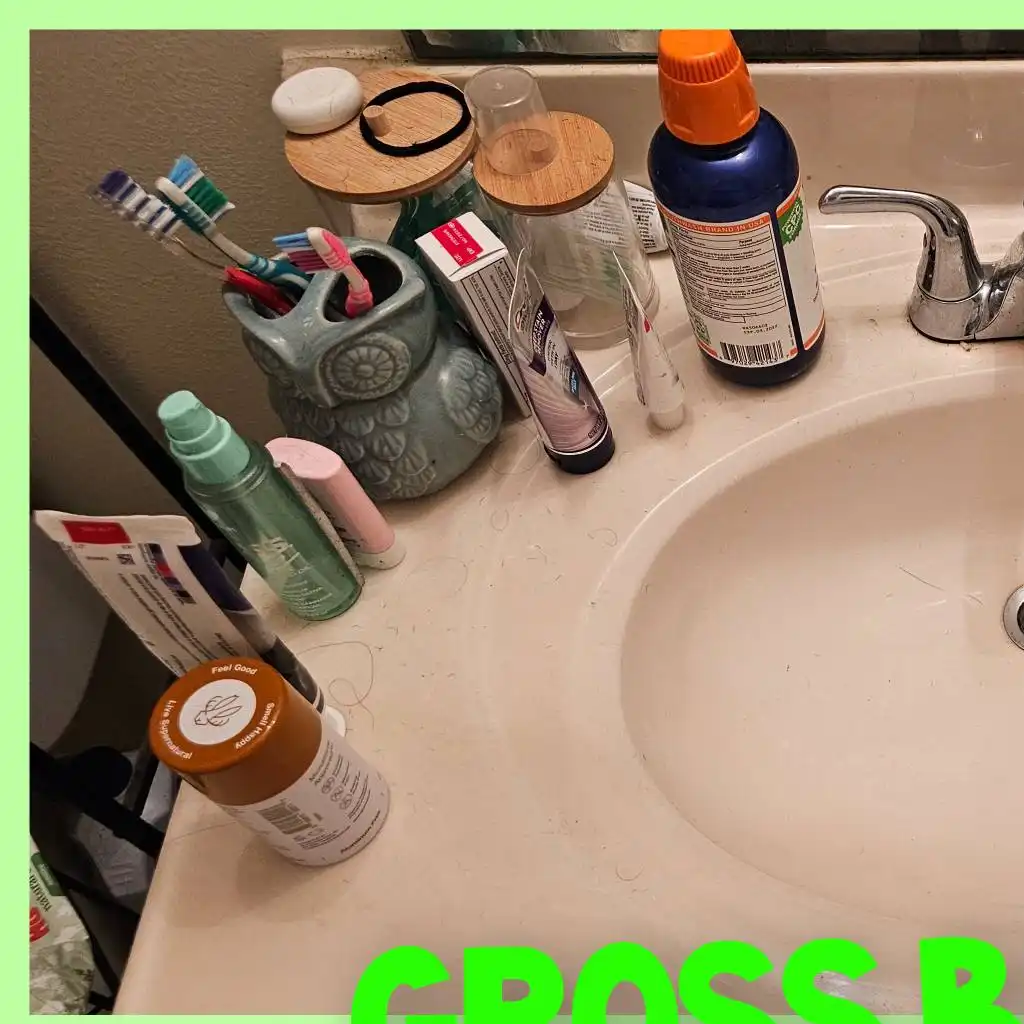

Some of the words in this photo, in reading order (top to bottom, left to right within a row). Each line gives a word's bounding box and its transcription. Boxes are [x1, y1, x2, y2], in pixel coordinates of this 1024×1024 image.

[211, 664, 232, 674] Feel
[234, 663, 258, 675] Good
[163, 700, 177, 718] Live
[260, 702, 275, 726] Smell
[159, 719, 193, 760] Supernatural
[235, 726, 263, 749] Happy
